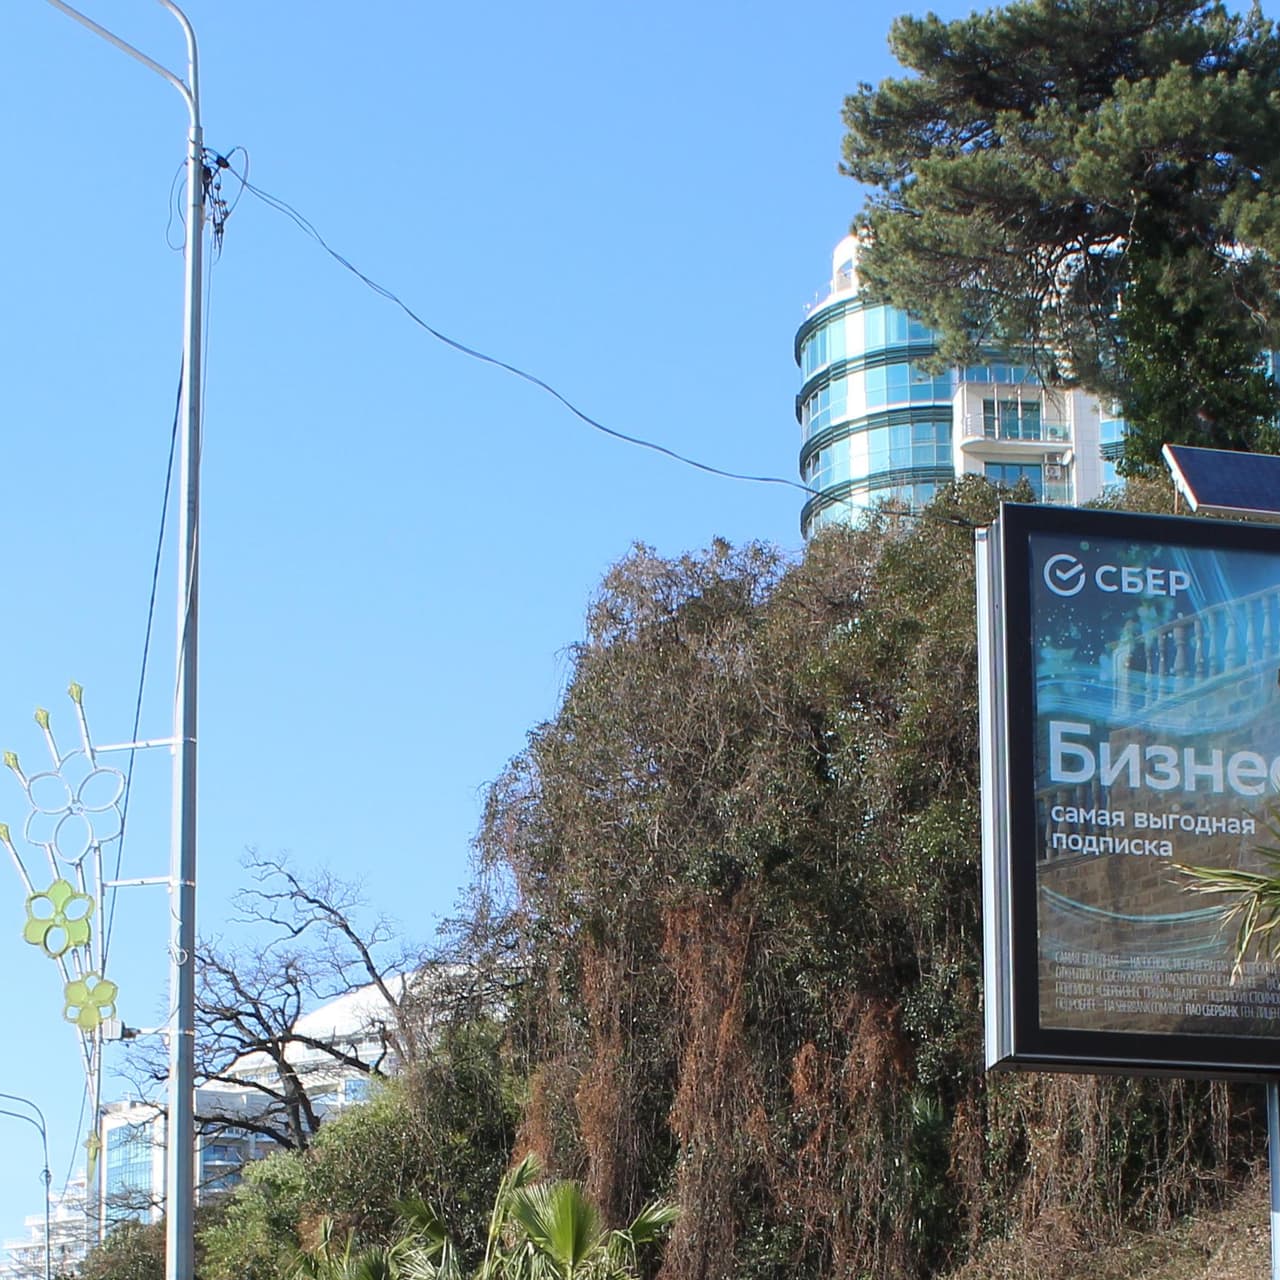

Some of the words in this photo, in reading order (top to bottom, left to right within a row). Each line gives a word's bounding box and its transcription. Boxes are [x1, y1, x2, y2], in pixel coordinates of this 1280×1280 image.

[1095, 565, 1191, 597] СБЕР
[1051, 805, 1125, 827] самая
[1134, 811, 1256, 836] выгодная
[1052, 833, 1173, 857] подписка
